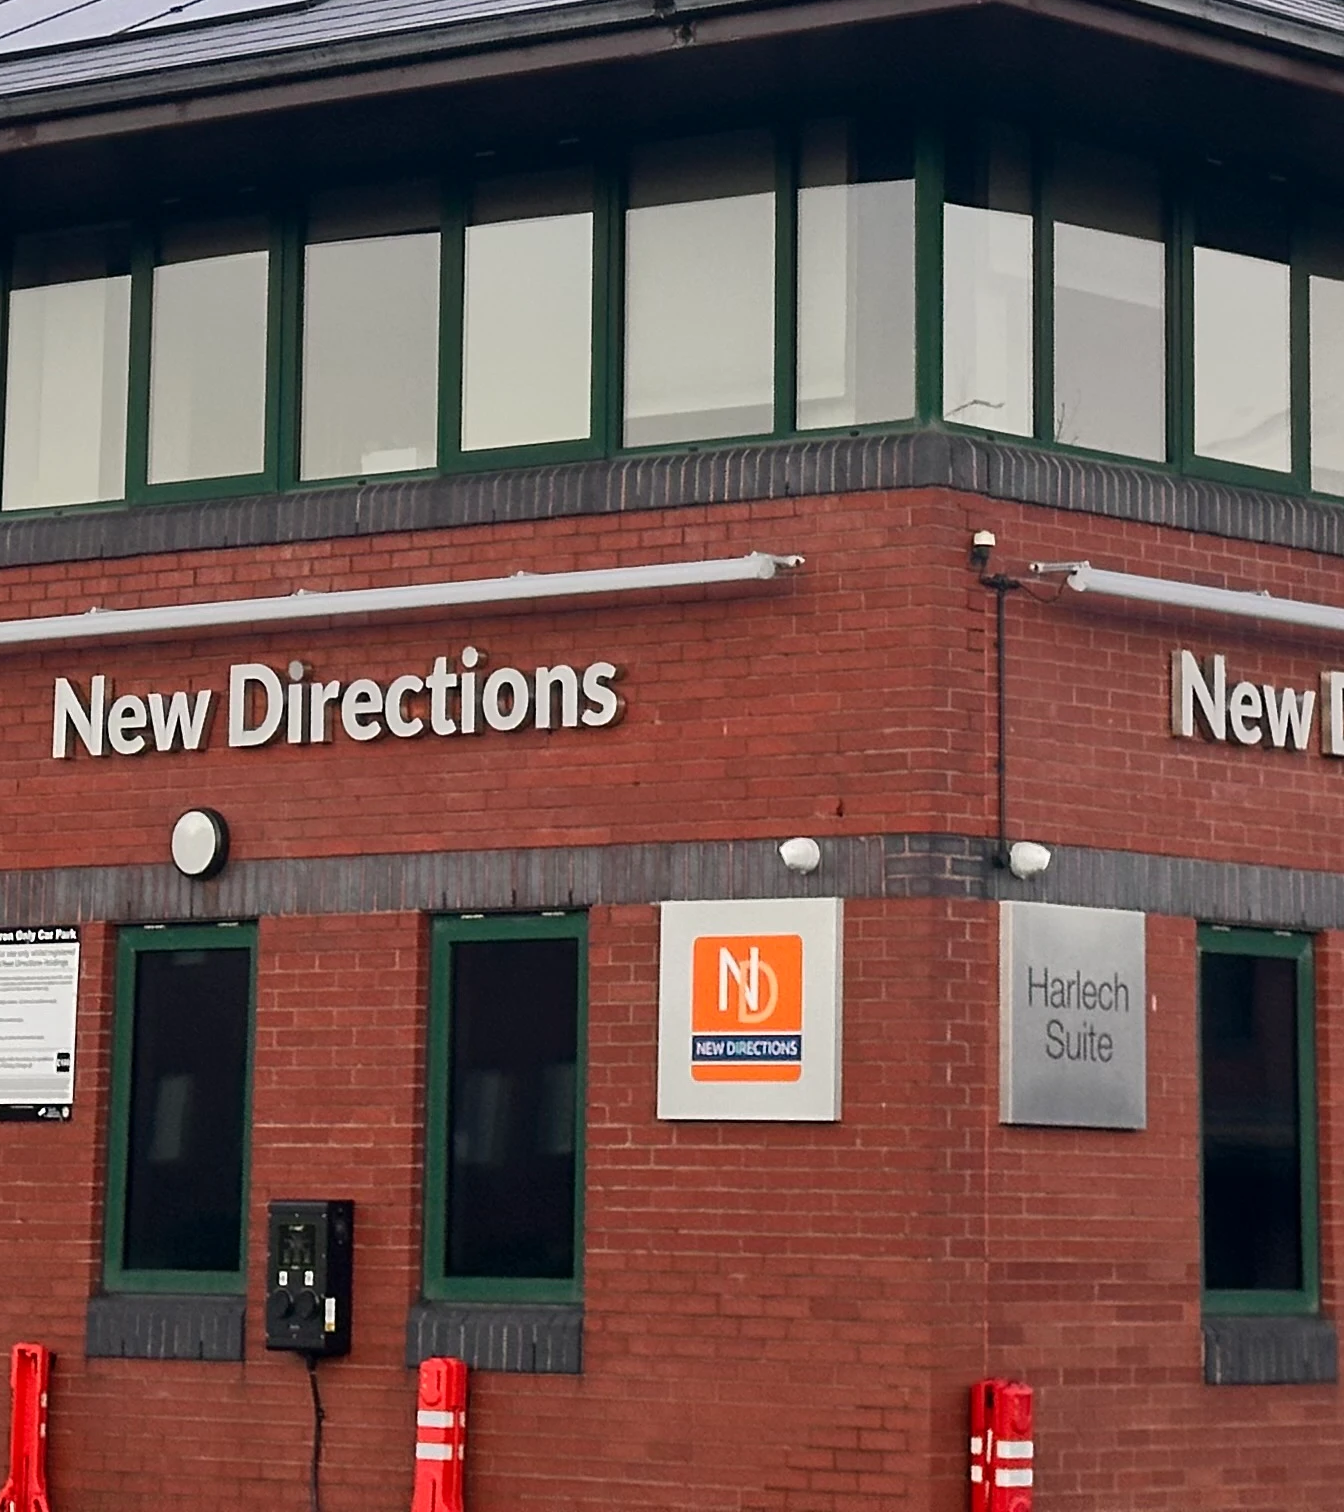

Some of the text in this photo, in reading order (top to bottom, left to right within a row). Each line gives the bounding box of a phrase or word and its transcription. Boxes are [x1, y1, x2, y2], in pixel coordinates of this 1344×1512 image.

[52, 645, 622, 758] New Directions
[1173, 649, 1316, 750] New
[16, 929, 36, 942] Only
[37, 929, 53, 940] Car
[55, 928, 76, 940] Park
[1027, 965, 1130, 1012] Harlech
[696, 1040, 798, 1056] NEW DIRECTIONS
[1045, 1018, 1114, 1063] Suite
